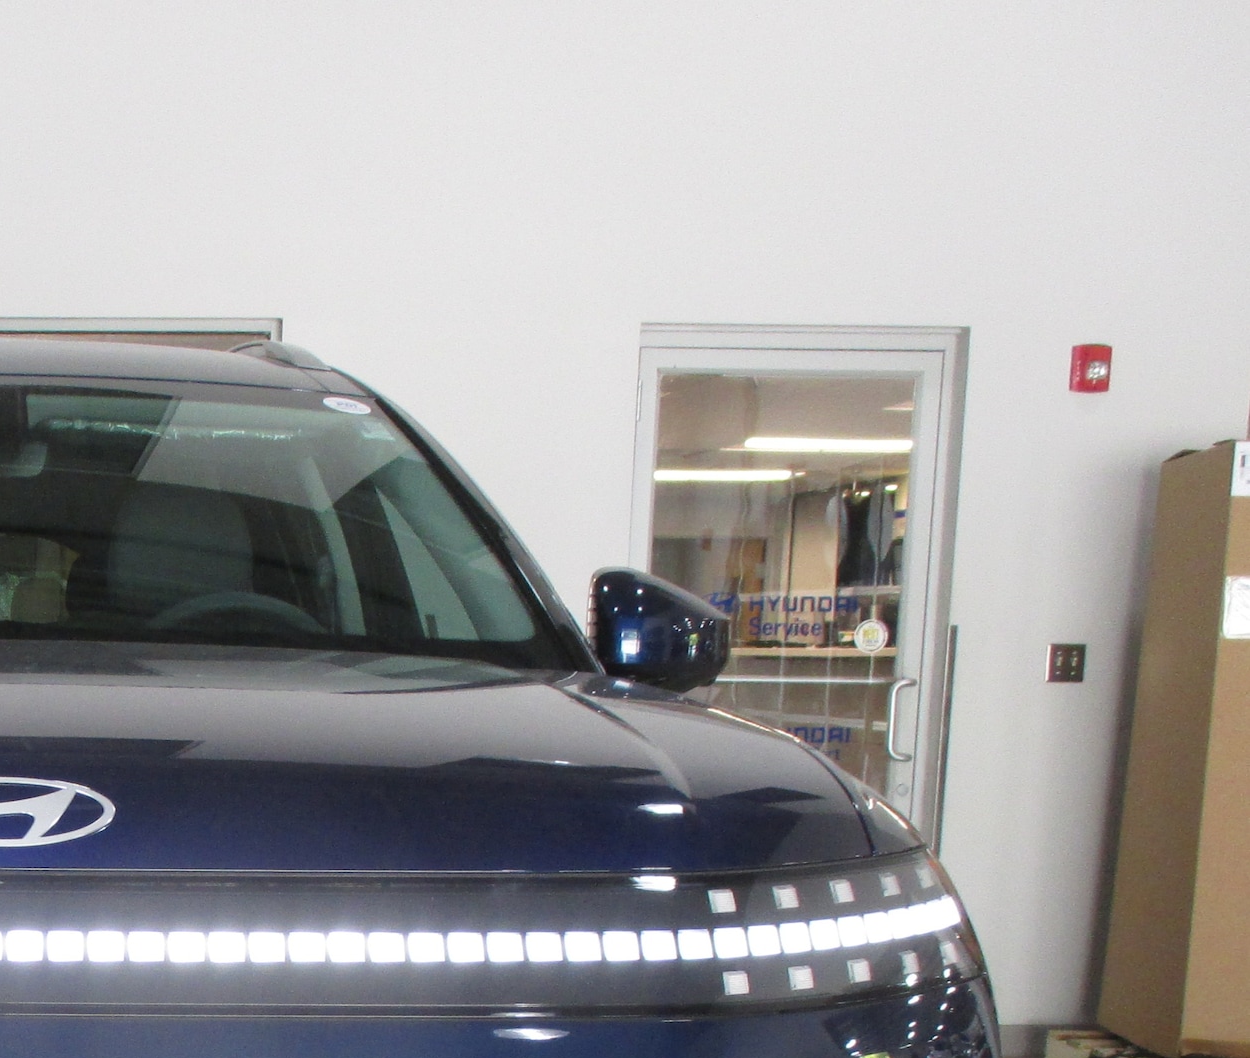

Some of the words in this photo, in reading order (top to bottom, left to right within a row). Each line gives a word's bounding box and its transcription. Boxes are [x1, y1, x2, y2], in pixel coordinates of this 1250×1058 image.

[749, 595, 859, 613] HYUNDAI
[749, 617, 823, 637] Service
[787, 726, 851, 743] NDAI
